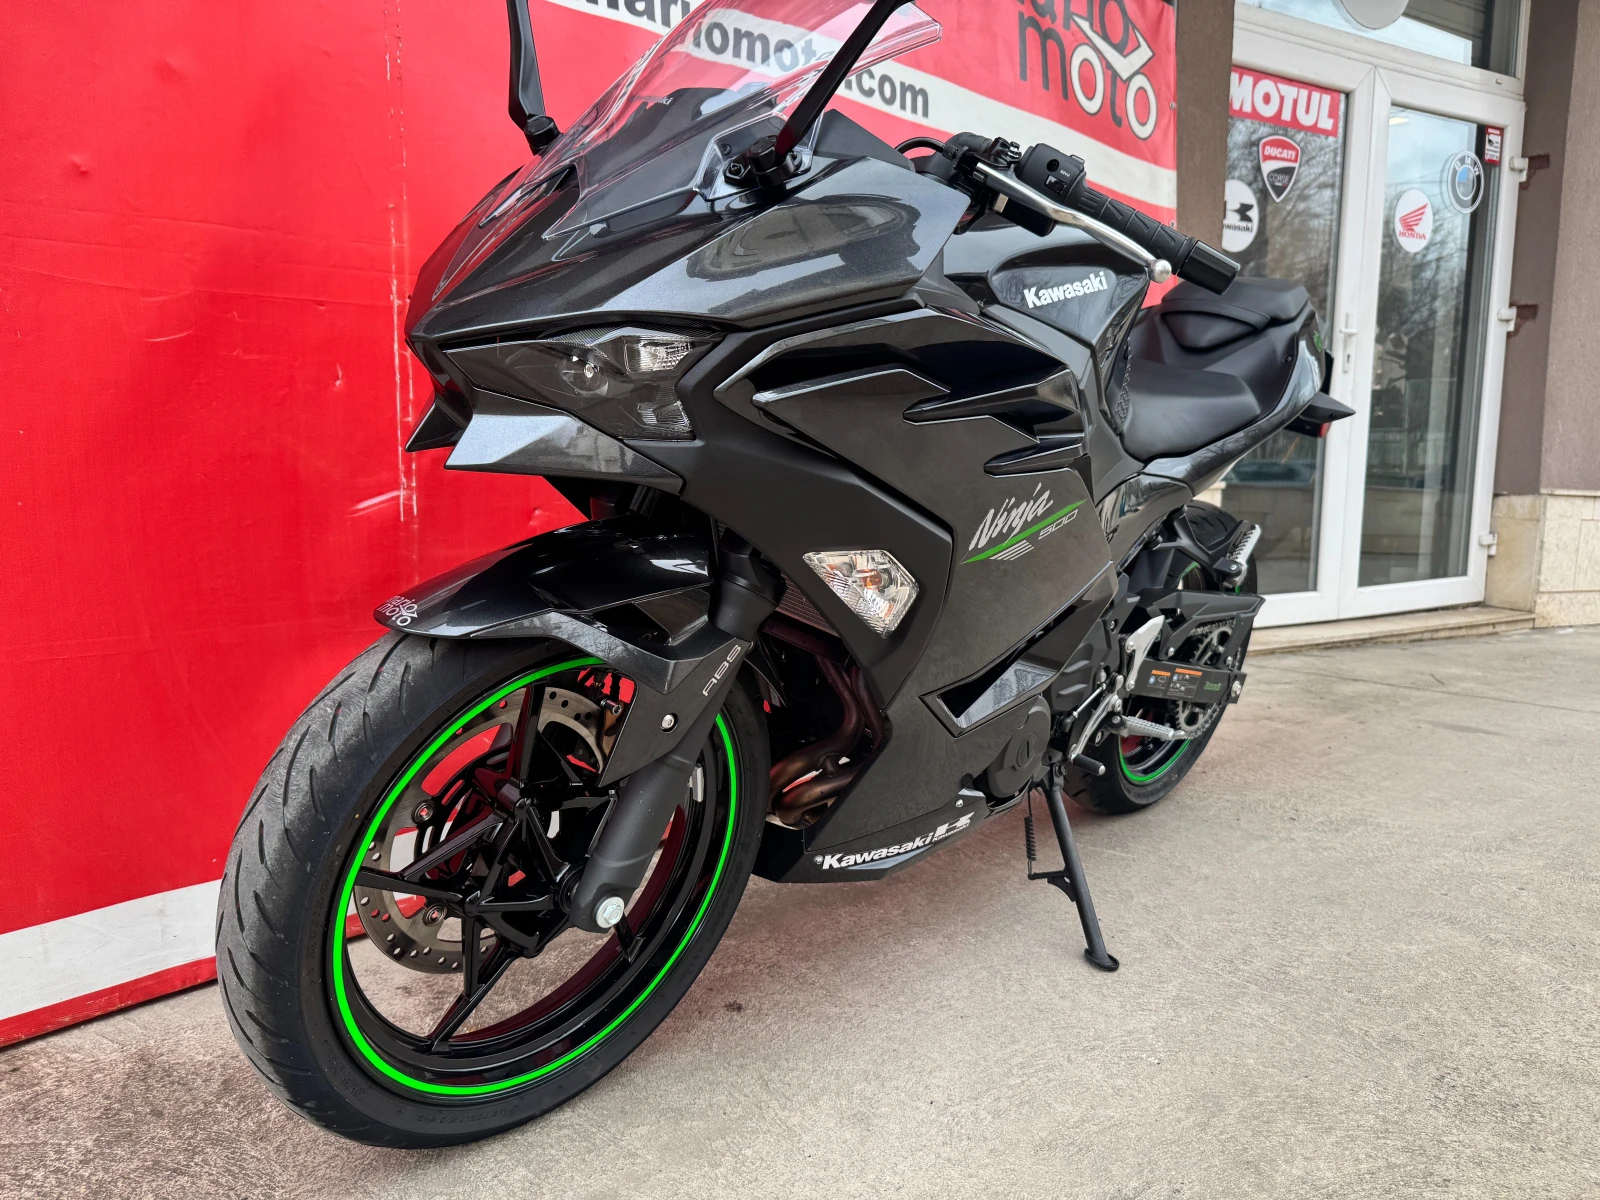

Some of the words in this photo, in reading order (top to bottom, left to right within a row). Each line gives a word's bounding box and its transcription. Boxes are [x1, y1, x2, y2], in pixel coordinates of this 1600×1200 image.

[1018, 11, 1158, 140] moto
[1230, 71, 1334, 131] MOTUL
[1264, 145, 1296, 160] DUCATI
[1454, 155, 1480, 177] BMW
[1223, 223, 1253, 233] wasaki
[1398, 230, 1427, 240] HONDA
[1023, 271, 1108, 308] Kawasaki
[967, 482, 1054, 551] Ninja
[1038, 509, 1079, 540] 500
[702, 644, 742, 697] ABS
[822, 832, 934, 870] Kawasaki
